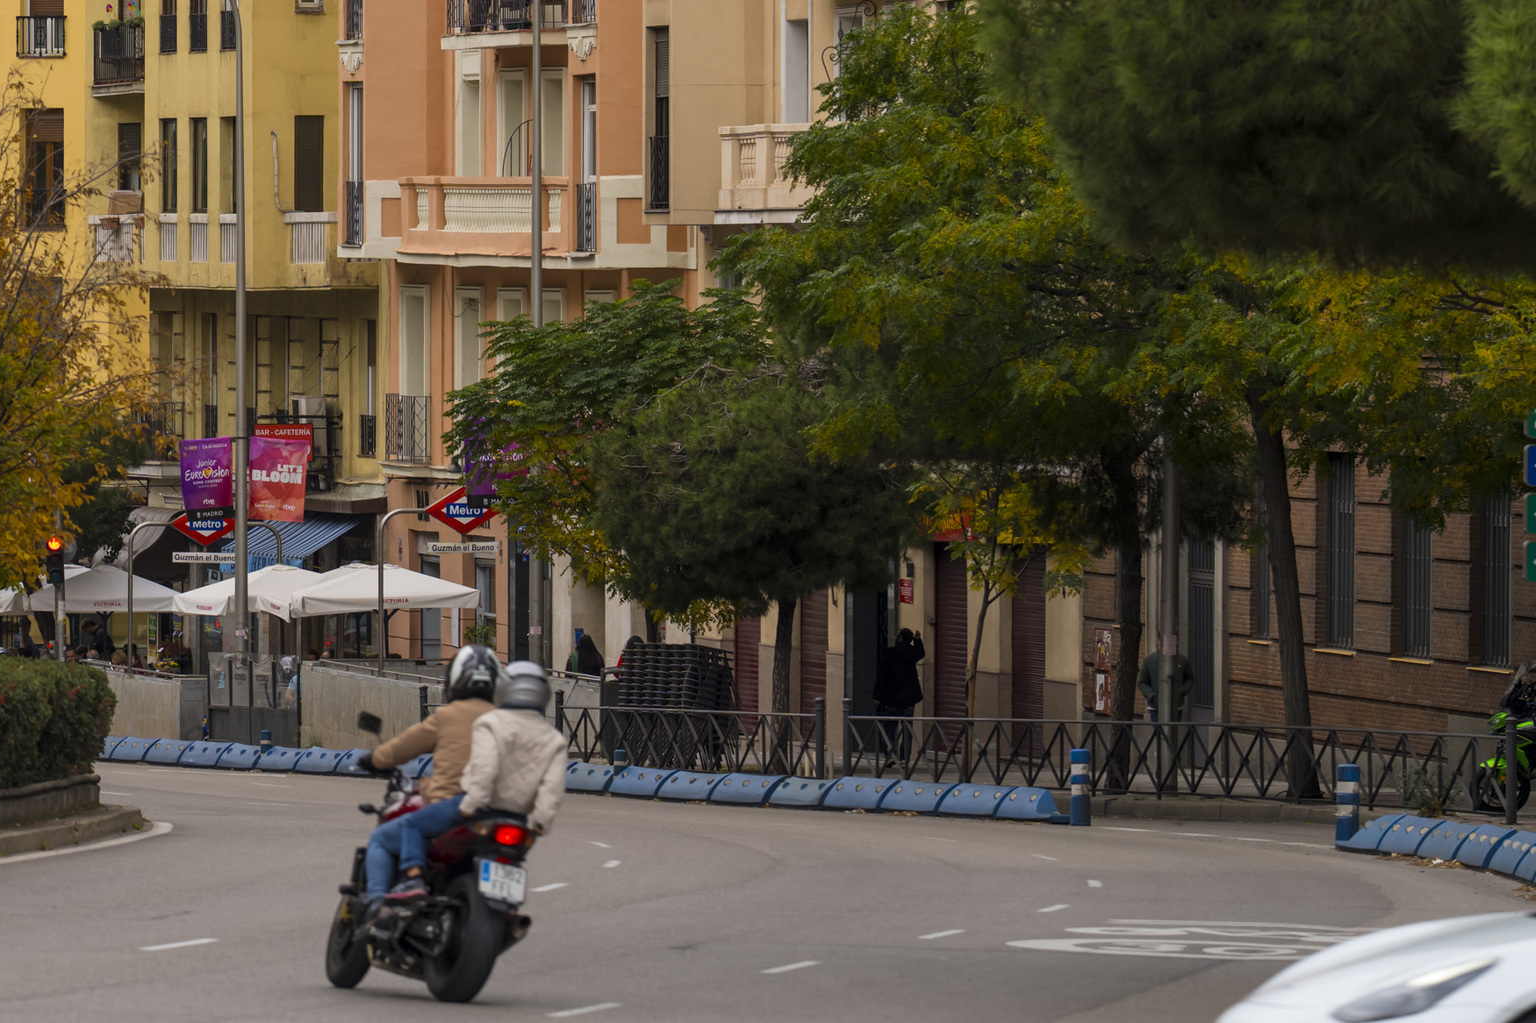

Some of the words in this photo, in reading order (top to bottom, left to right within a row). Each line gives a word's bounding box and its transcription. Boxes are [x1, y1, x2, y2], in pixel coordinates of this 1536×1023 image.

[274, 428, 310, 436] CAFETERÍA
[196, 458, 217, 468] Junior
[278, 464, 303, 473] LET'S
[252, 470, 302, 484] BLOOM
[449, 506, 480, 515] Metro
